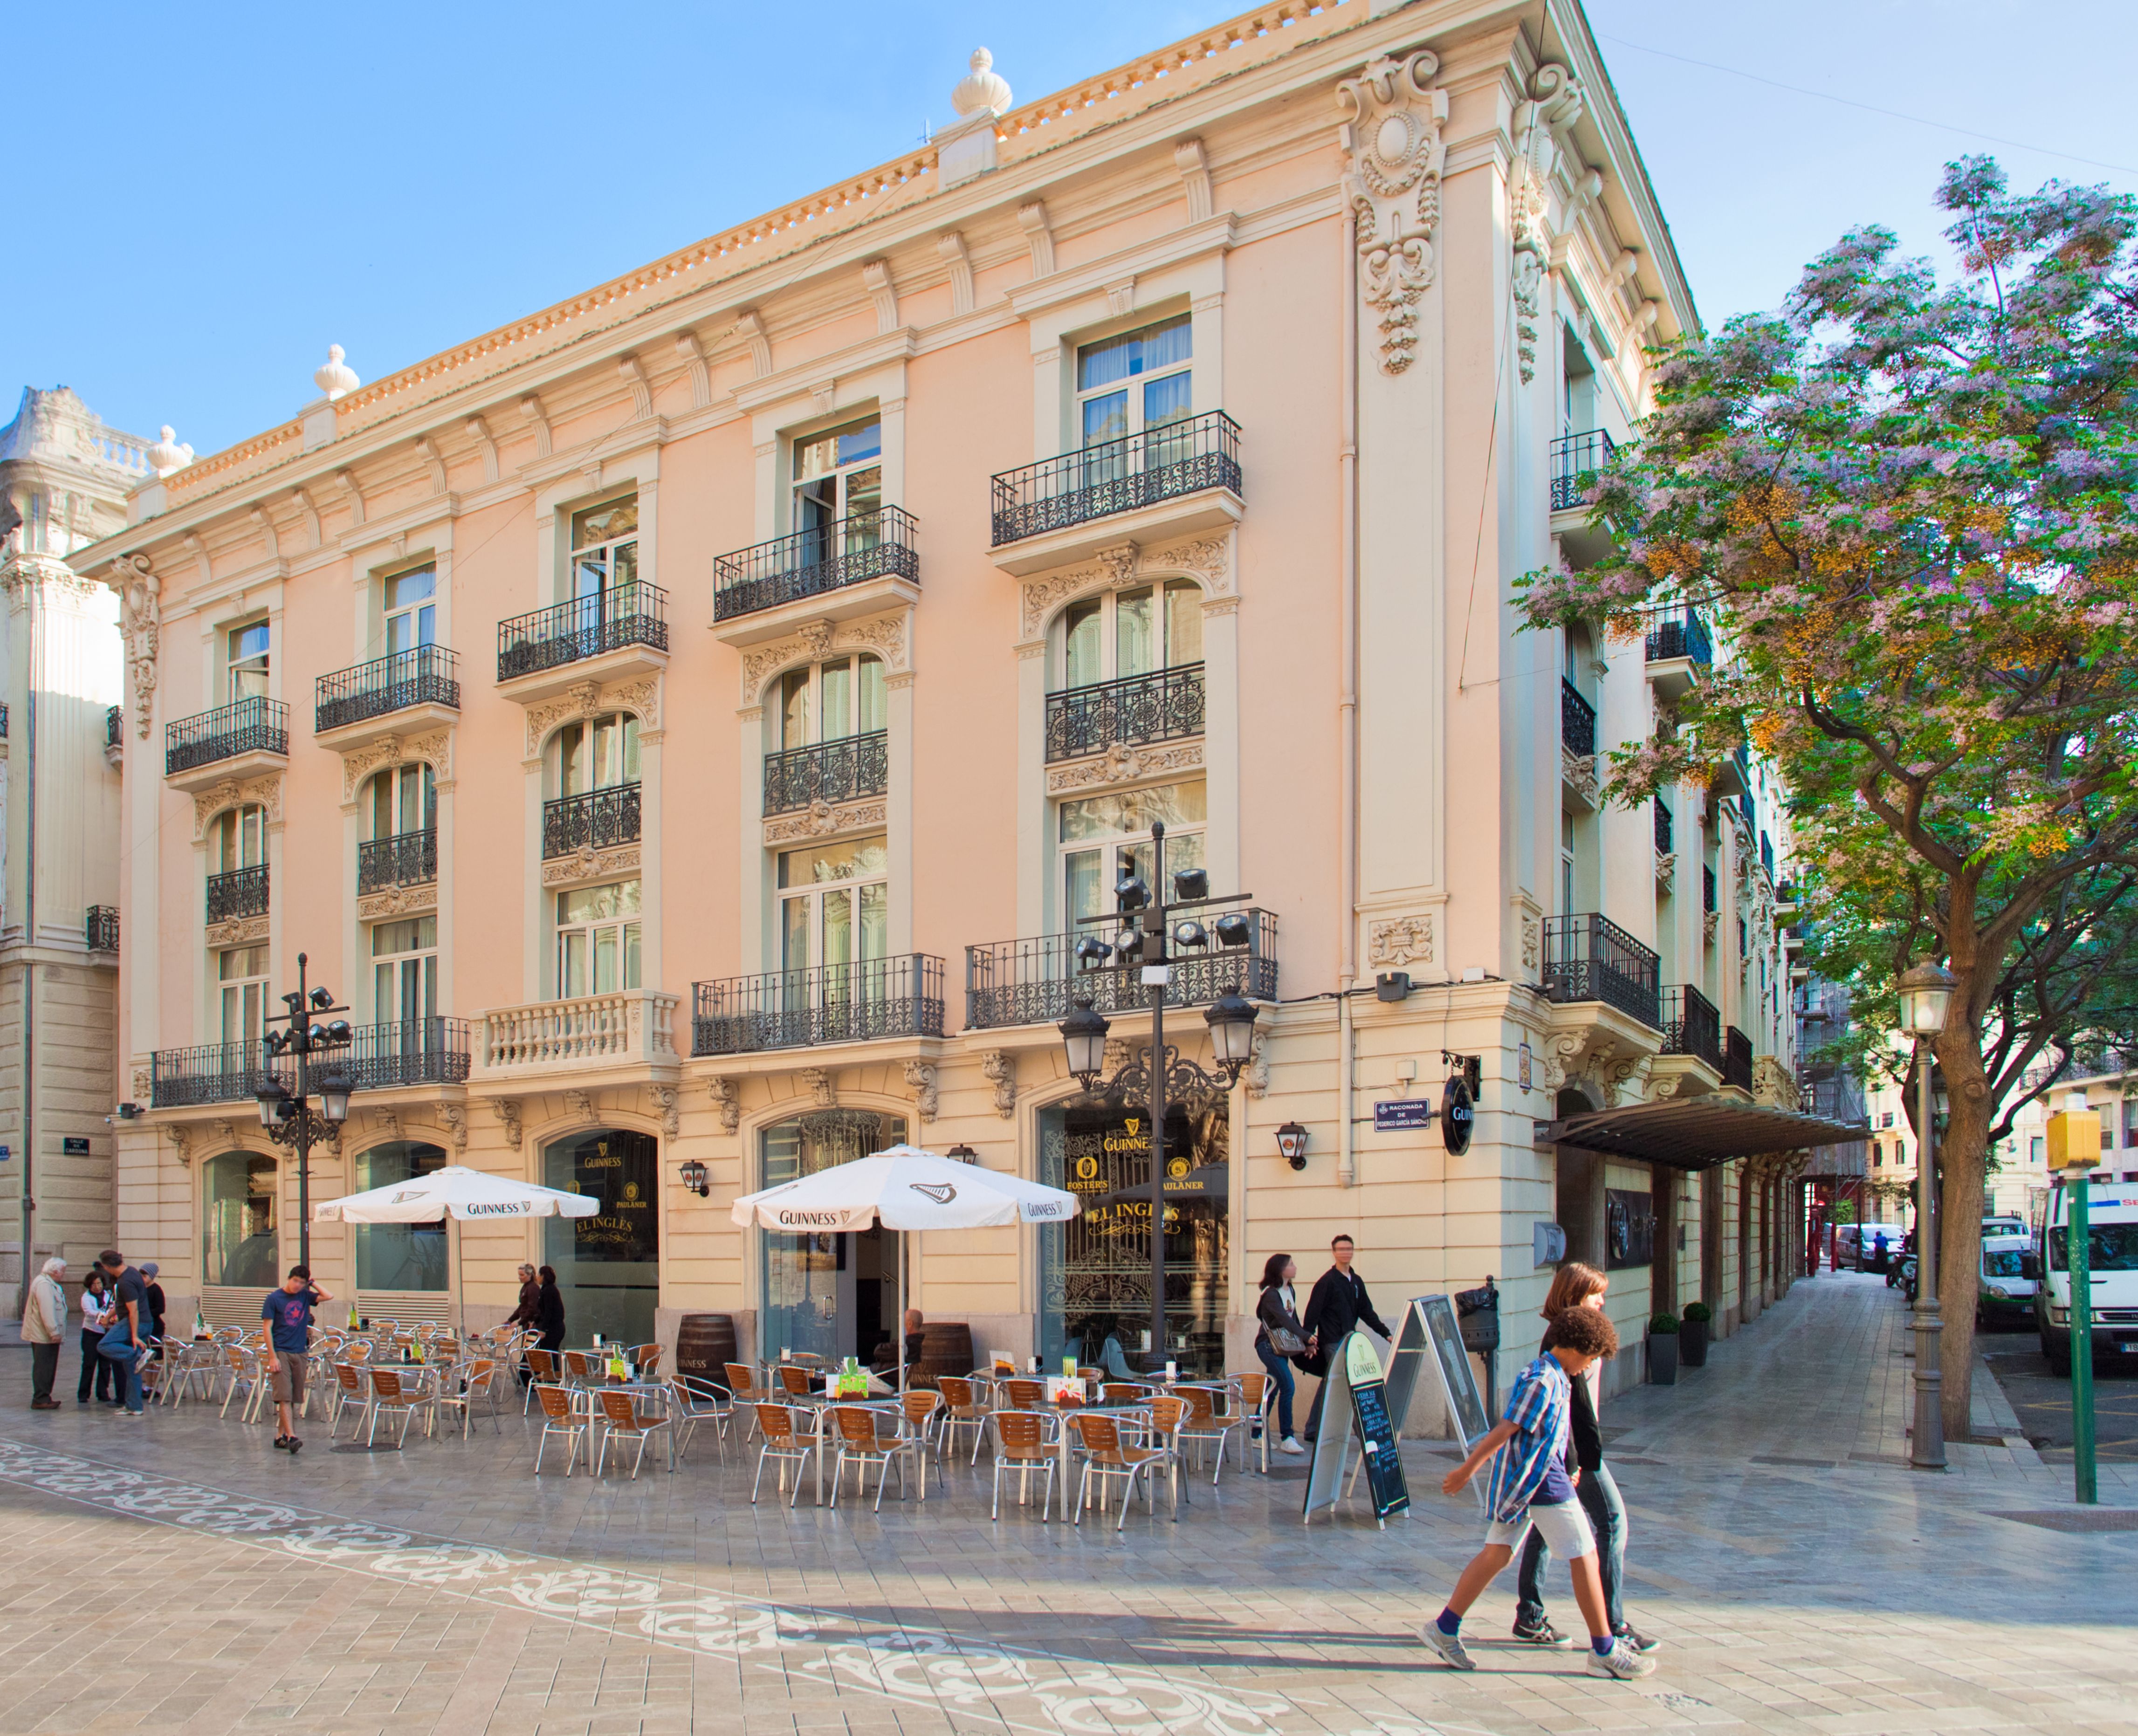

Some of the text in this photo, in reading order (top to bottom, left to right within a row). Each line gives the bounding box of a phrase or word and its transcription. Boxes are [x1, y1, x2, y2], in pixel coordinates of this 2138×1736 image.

[1104, 1137, 1153, 1152] GUINNE
[584, 1157, 621, 1168] GUINNESS
[1066, 1180, 1108, 1190] FOSTER'S
[1163, 1181, 1204, 1190] AULANER
[467, 1202, 519, 1215] GUINNESS
[1028, 1202, 1056, 1217] GUINNESS
[1090, 1207, 1113, 1223] EL
[576, 1216, 632, 1233] EL INGLÈS
[779, 1210, 836, 1225] GUINNESS
[677, 1359, 707, 1368] UINNESS
[1354, 1362, 1376, 1378] GUINNESS
